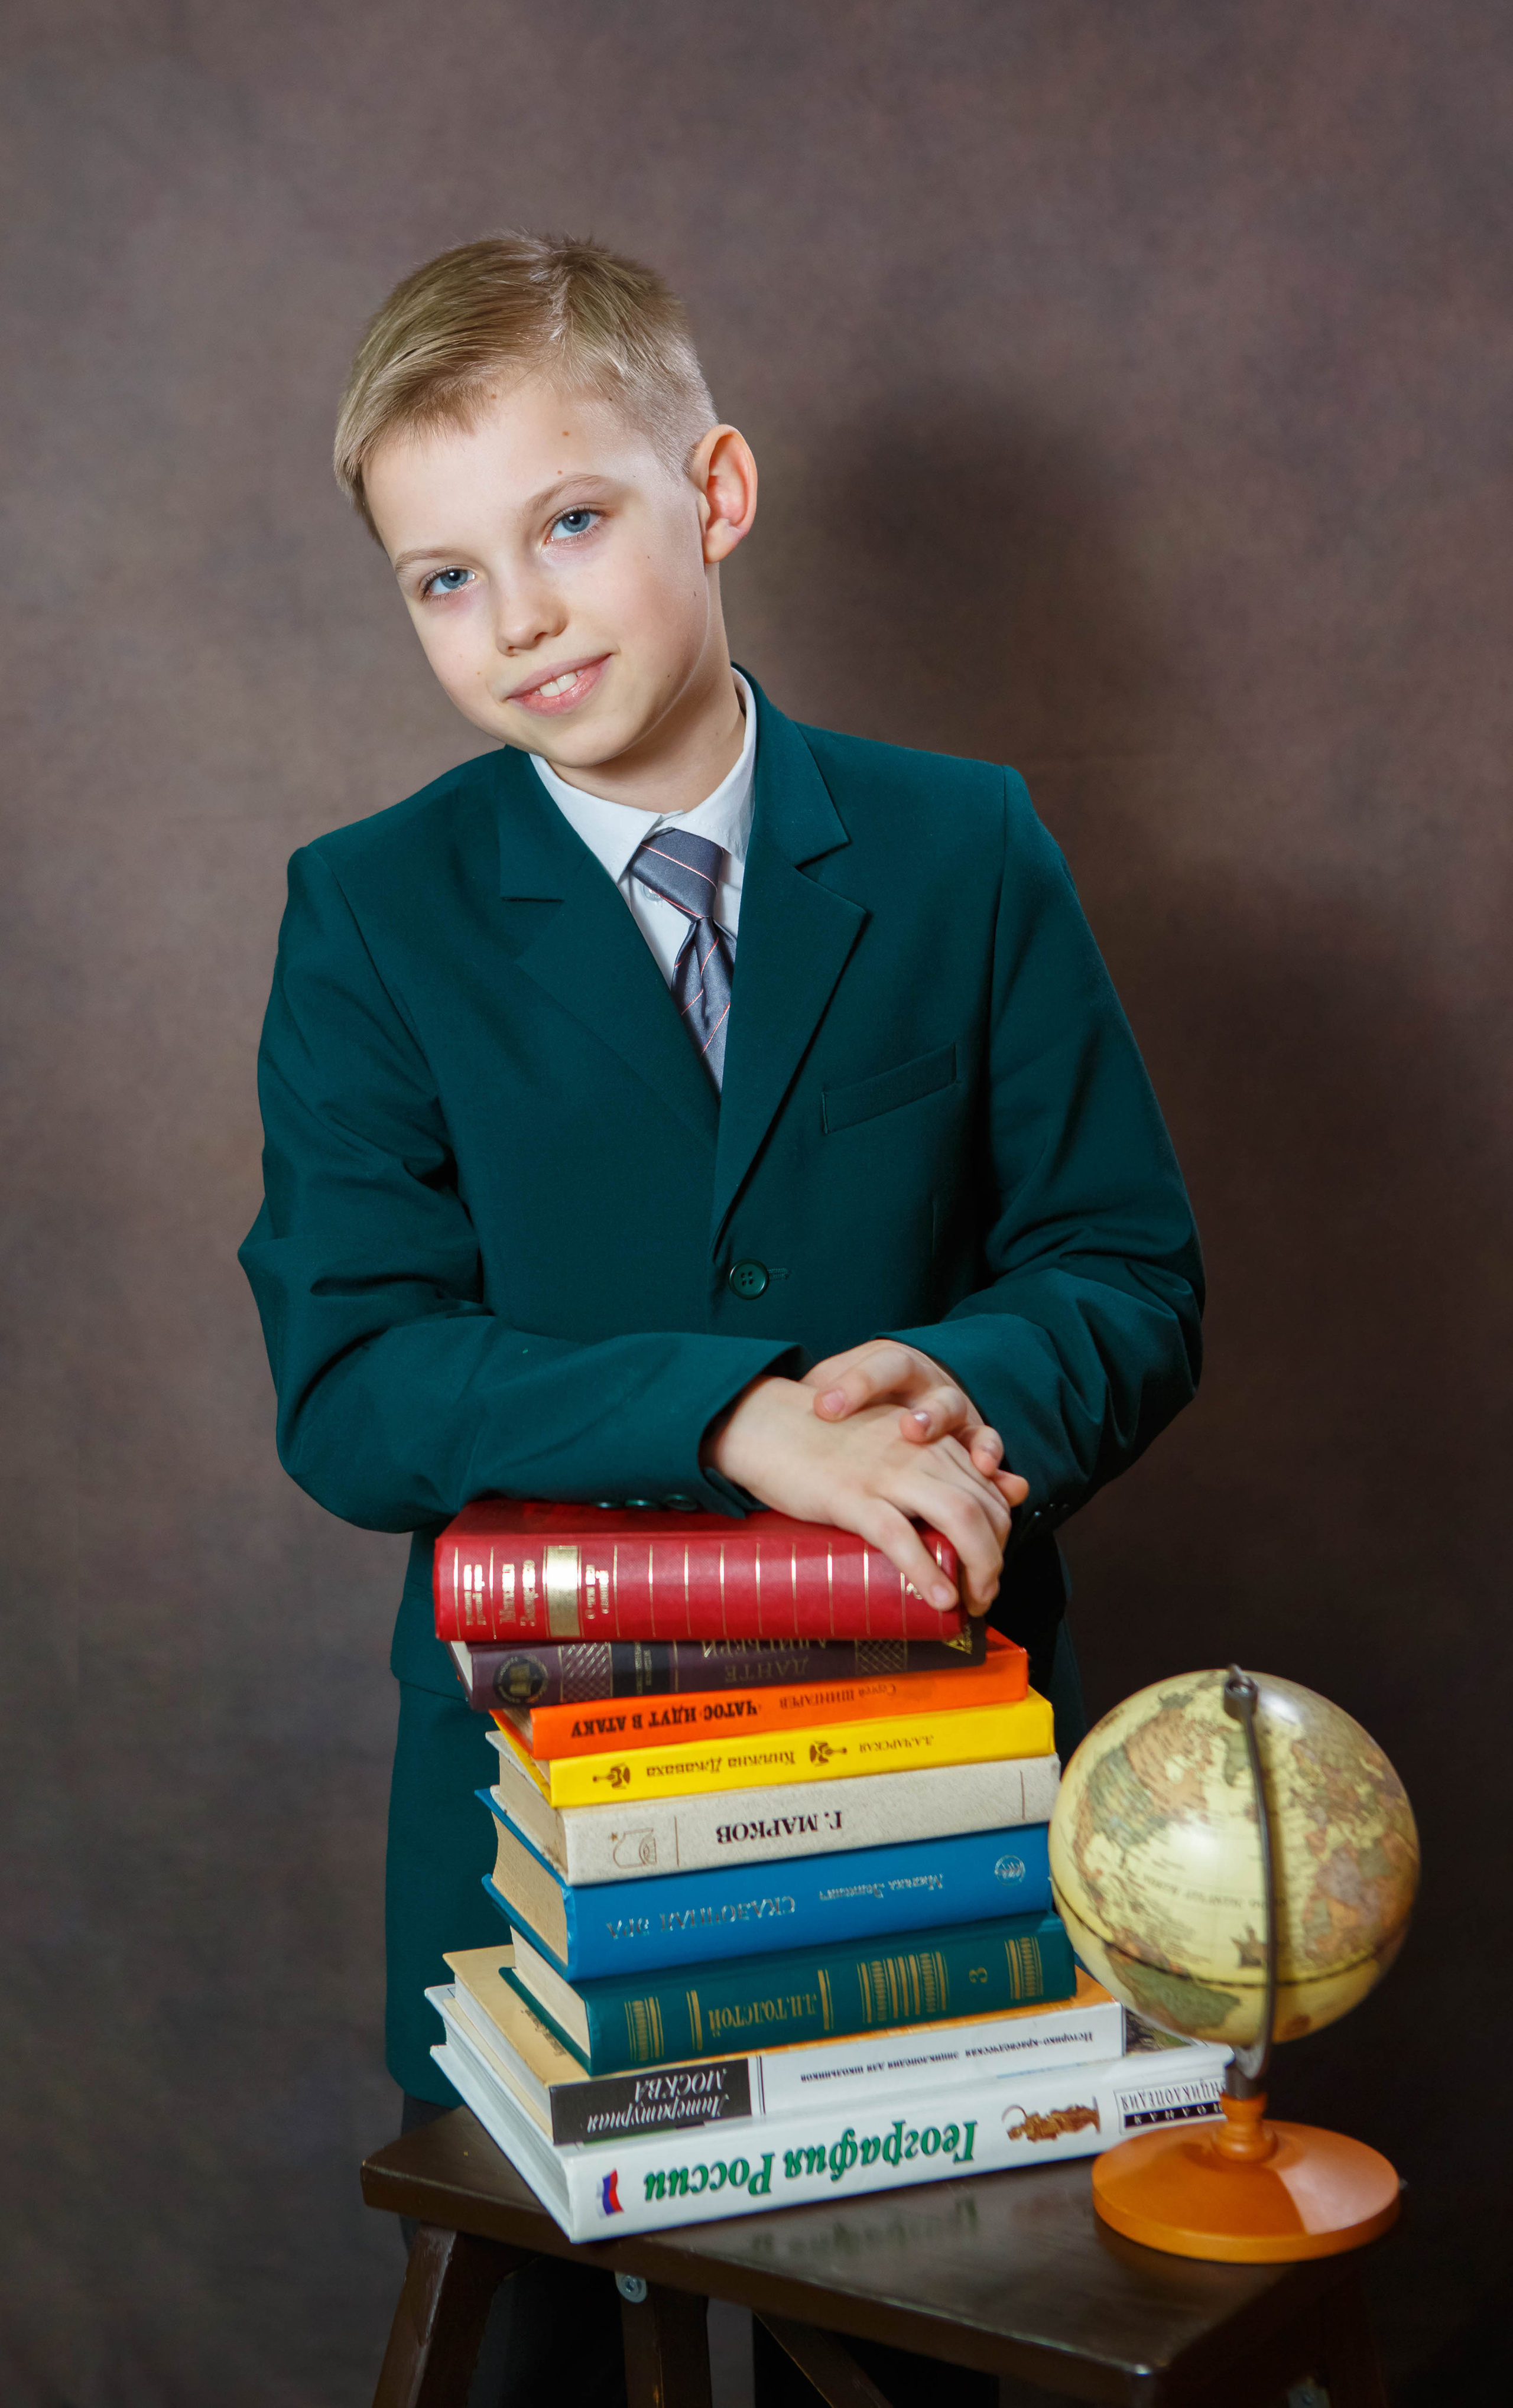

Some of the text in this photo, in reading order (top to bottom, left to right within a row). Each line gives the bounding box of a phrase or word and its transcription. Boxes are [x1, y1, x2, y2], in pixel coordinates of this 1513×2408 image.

[725, 1656, 809, 1683] ДАНТЕ
[780, 1689, 855, 1709] ШИНГАРЕВ
[572, 1716, 626, 1738] АТАКУ
[632, 1714, 643, 1729] В
[648, 1704, 696, 1727] ИДУТ
[647, 1751, 796, 1777] Княжна Джаваха
[716, 1810, 842, 1845] Г. МАРКОВ
[606, 1896, 796, 1941] СКАЗОЧНАЯ ЭРА
[969, 1965, 988, 1983] 3
[635, 2068, 728, 2103] МОСКВА
[800, 2066, 864, 2082] школьников
[587, 2094, 730, 2133] Литературная
[644, 2120, 978, 2201] География России
